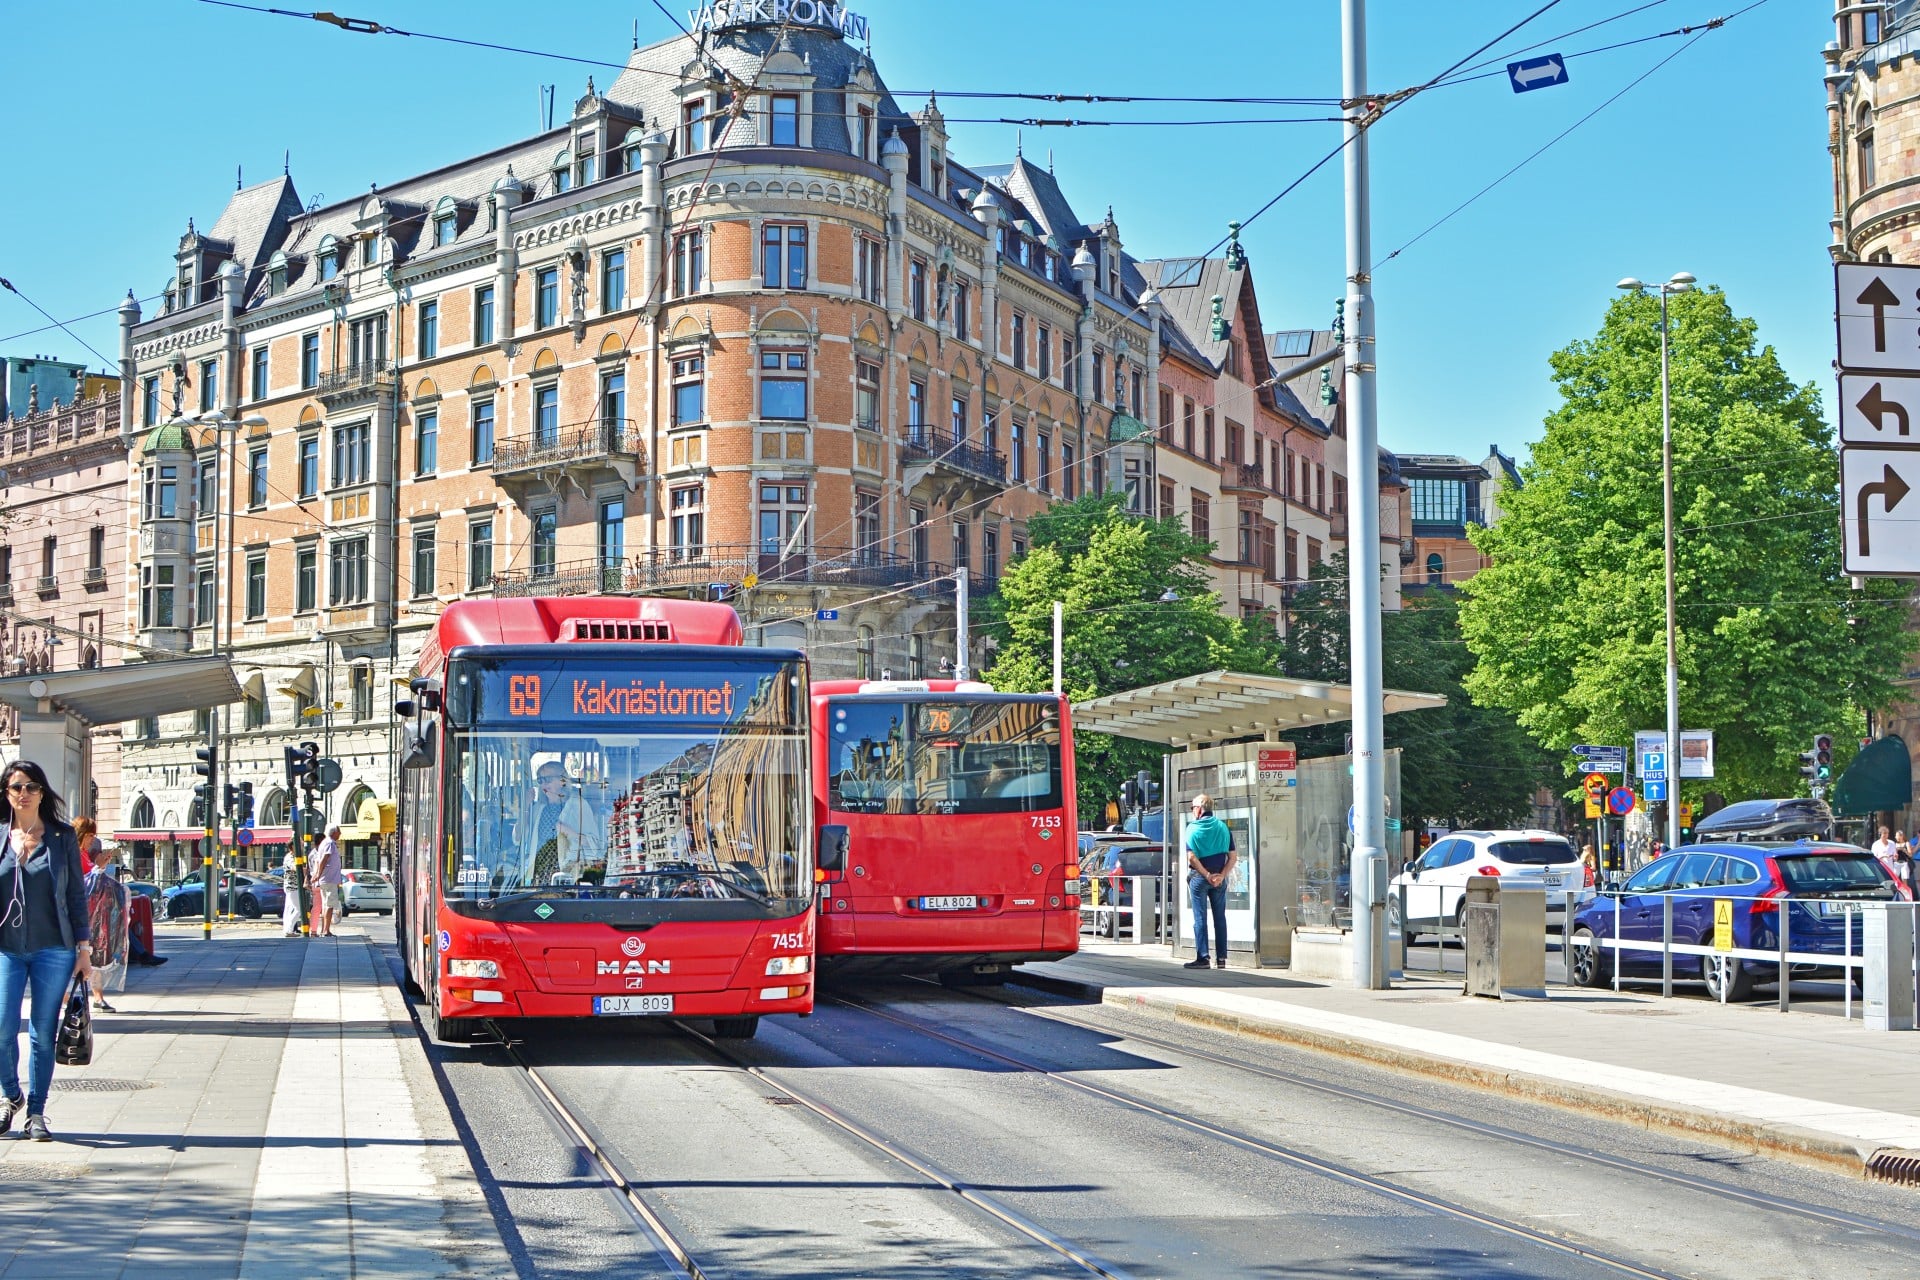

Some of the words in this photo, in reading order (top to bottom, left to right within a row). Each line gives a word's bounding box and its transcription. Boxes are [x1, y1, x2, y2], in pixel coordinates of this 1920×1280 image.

[688, 0, 867, 40] VASAKRONAN
[823, 611, 832, 619] 12
[509, 675, 541, 716] 69
[573, 680, 732, 715] Kaknästornet
[929, 710, 951, 732] 76
[1649, 754, 1660, 769] P
[1260, 771, 1271, 779] 69
[1273, 771, 1283, 779] 76
[1646, 771, 1663, 779] HUS
[1031, 816, 1061, 828] 7153
[929, 897, 949, 908] ELA
[952, 896, 972, 907] 802
[628, 940, 639, 949] SL
[771, 933, 803, 950] 7451
[597, 959, 671, 975] MAN
[603, 998, 631, 1012] CJX
[642, 997, 669, 1010] 809
